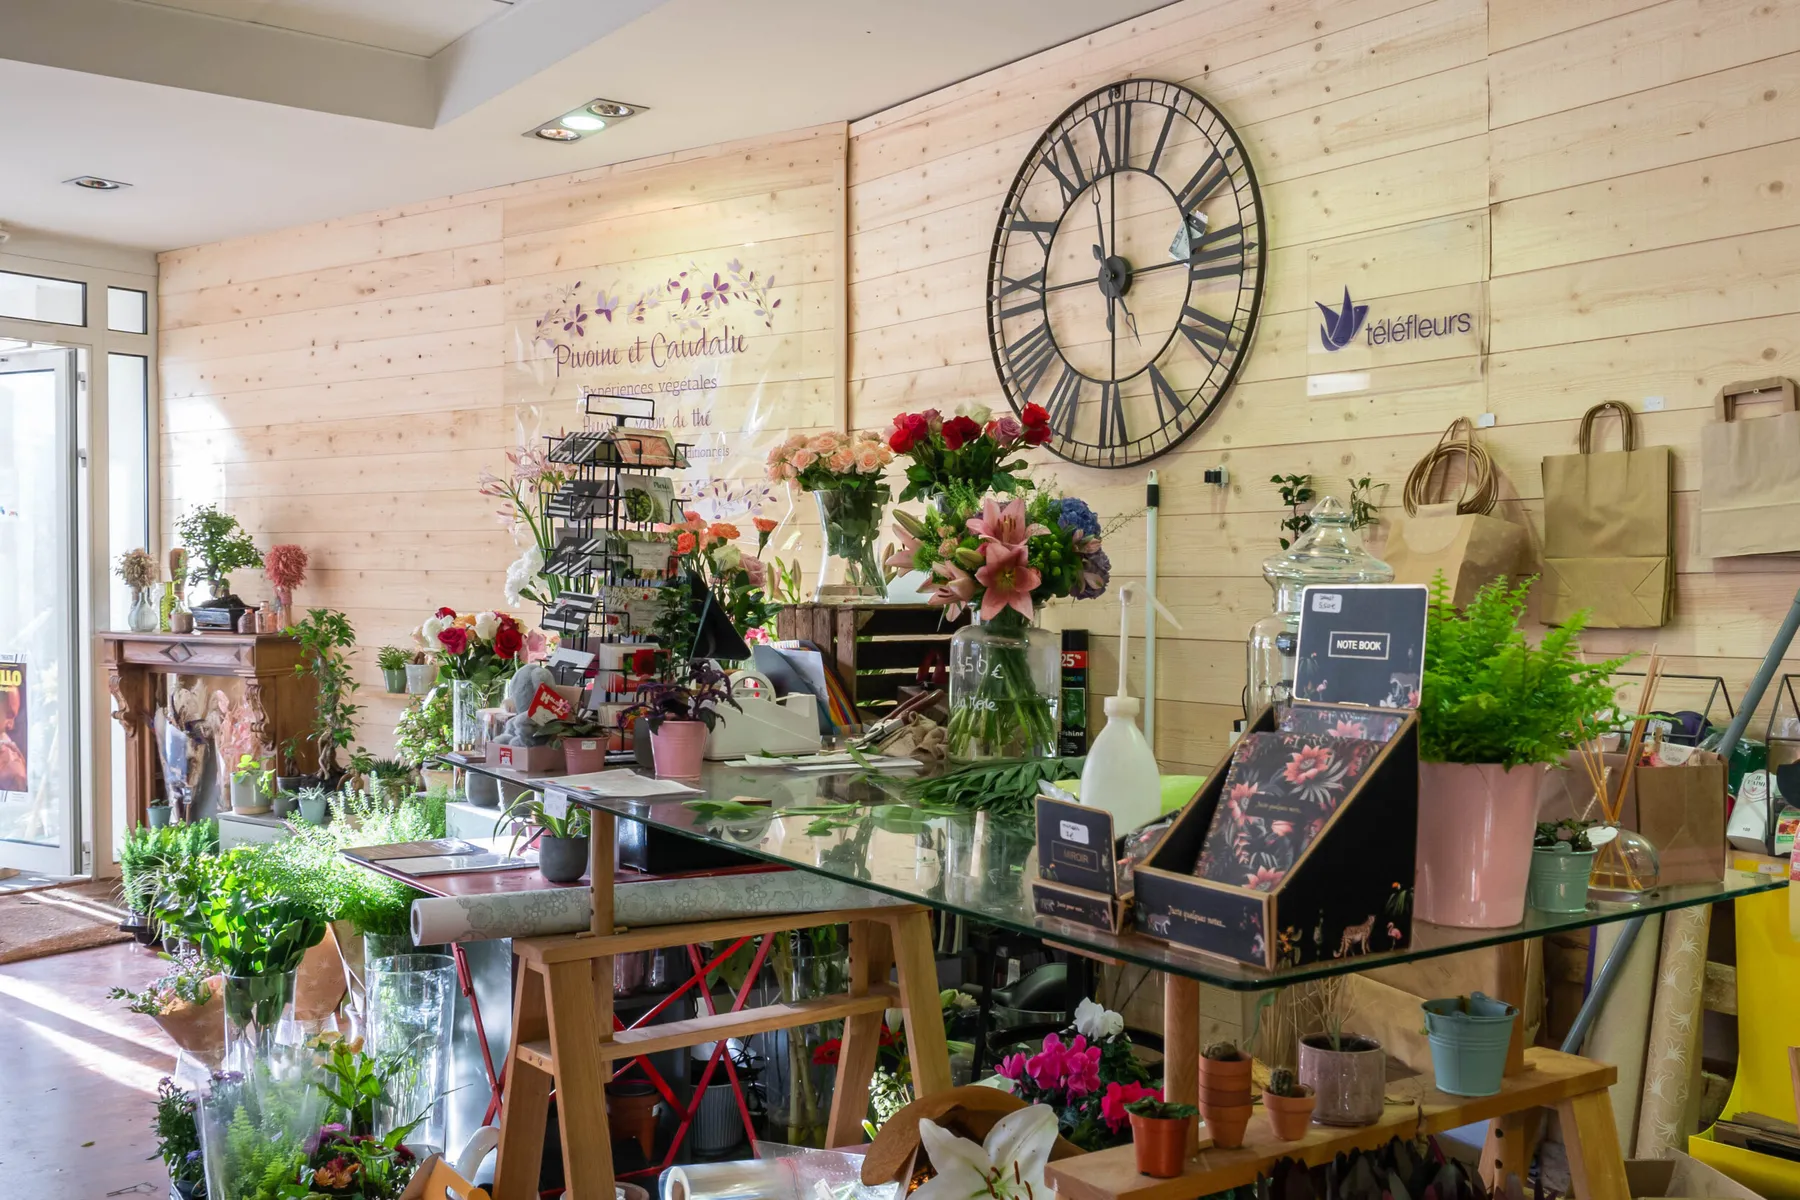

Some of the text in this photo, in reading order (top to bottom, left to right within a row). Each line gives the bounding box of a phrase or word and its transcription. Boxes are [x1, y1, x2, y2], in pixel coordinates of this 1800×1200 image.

[1365, 312, 1471, 346] téléfleurs
[552, 325, 749, 377] Pivoine et Caudalie
[583, 375, 718, 399] Expériences végétales
[672, 409, 688, 428] de
[691, 407, 713, 427] thé
[1336, 640, 1381, 651] NOTE BOOK
